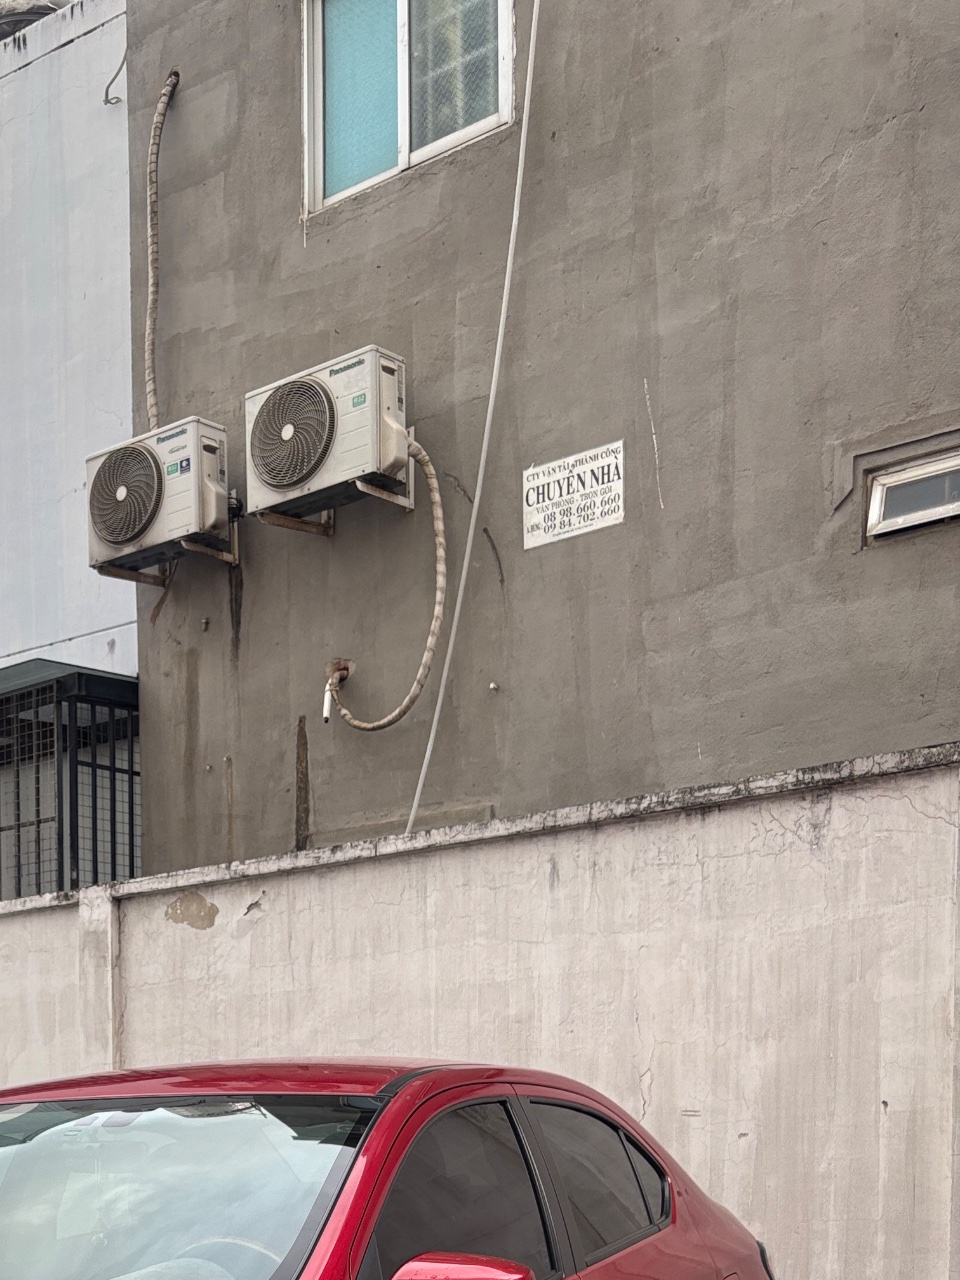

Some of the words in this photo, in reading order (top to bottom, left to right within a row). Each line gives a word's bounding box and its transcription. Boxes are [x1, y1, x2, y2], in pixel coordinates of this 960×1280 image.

[329, 358, 365, 378] Panasonic
[156, 428, 188, 445] Panasonic
[526, 473, 540, 483] CTY
[542, 466, 557, 478] VẬN
[557, 461, 570, 473] TẢI
[574, 453, 599, 468] THÀNH
[600, 446, 621, 460] CÔNG
[525, 463, 586, 507] CHUYỂN
[590, 455, 621, 489] NHÀ
[551, 496, 575, 511] PHÒNG
[600, 485, 613, 496] GÓI
[543, 511, 556, 524] 08
[543, 523, 556, 534] 09
